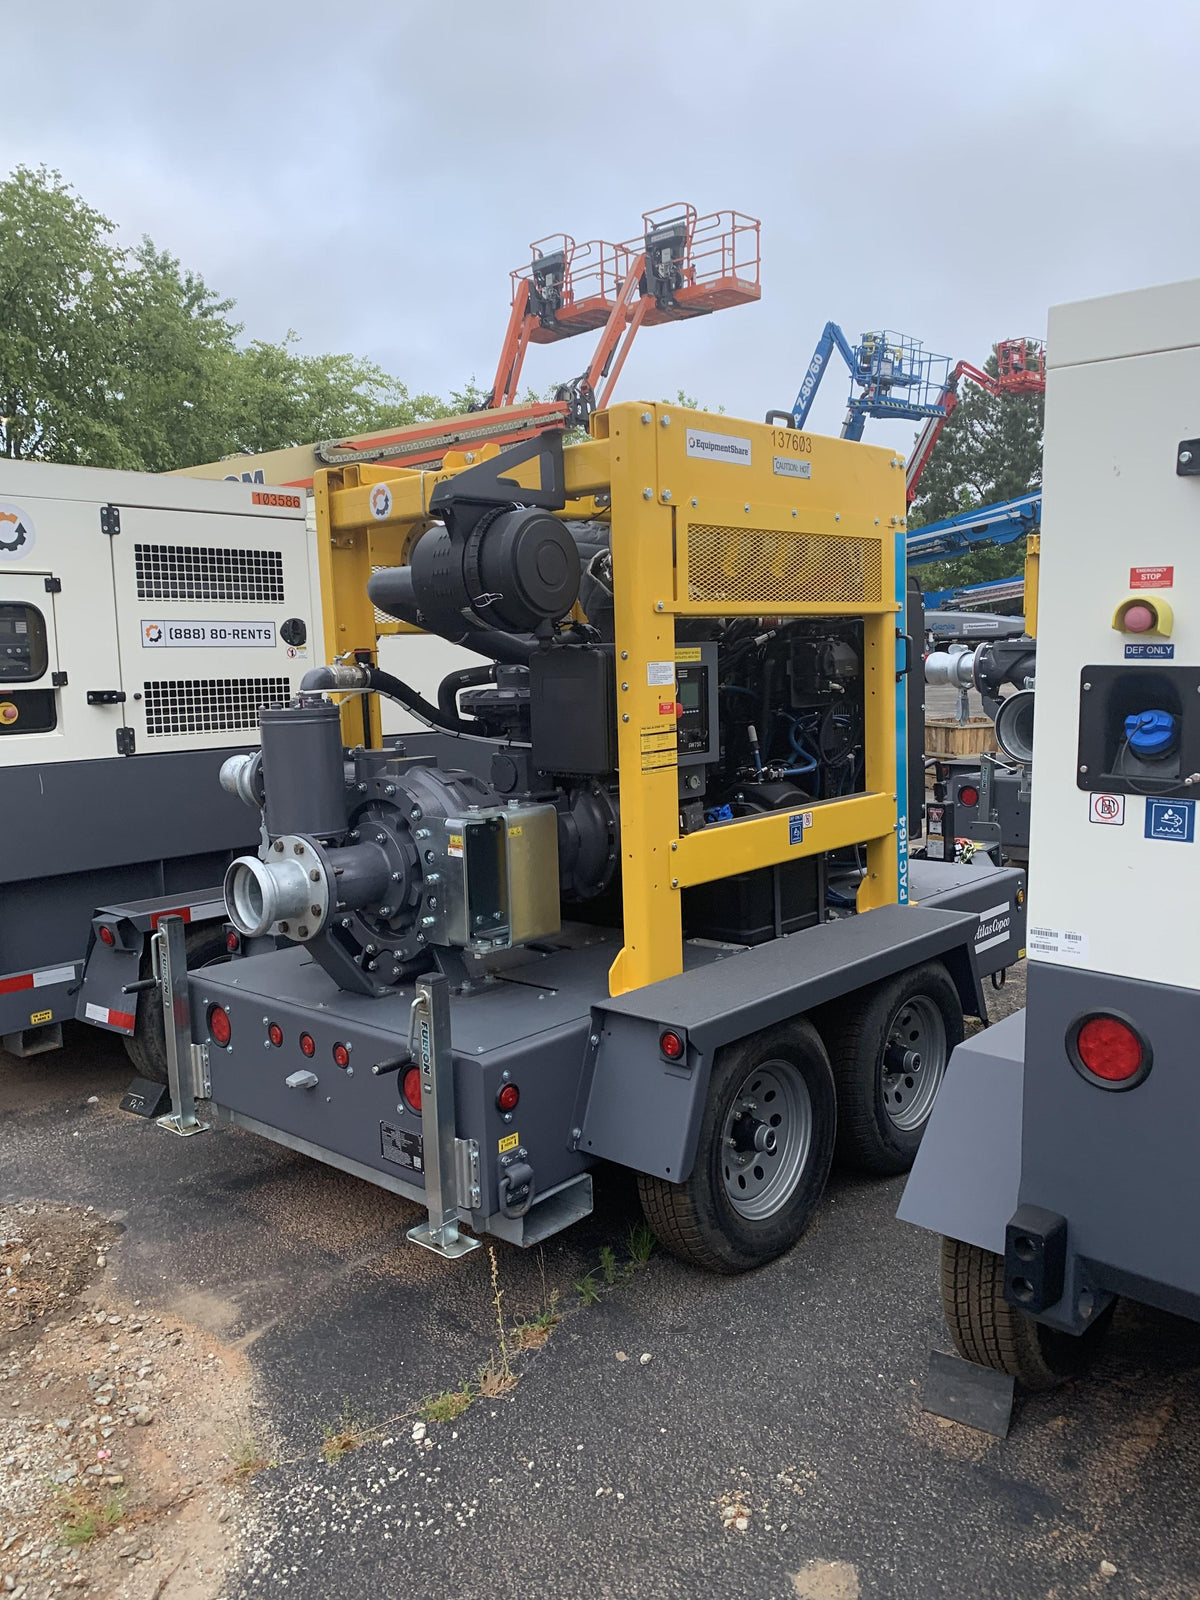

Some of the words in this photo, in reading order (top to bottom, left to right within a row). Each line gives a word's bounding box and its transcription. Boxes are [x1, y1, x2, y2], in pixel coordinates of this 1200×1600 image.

[796, 353, 823, 410] Z-80/60
[695, 438, 749, 456] EquipmentShare
[770, 430, 812, 453] 137603
[799, 465, 810, 474] HOT
[255, 493, 301, 508] 103586
[1140, 573, 1162, 581] STOP
[169, 627, 206, 640] (888)
[210, 628, 271, 640] 80-RENTS
[931, 622, 955, 631] Genie
[1125, 646, 1144, 654] DEF
[1146, 646, 1172, 654] ONLY
[898, 815, 907, 854] H64
[899, 860, 908, 900] PAC
[420, 1019, 431, 1077] FULTON
